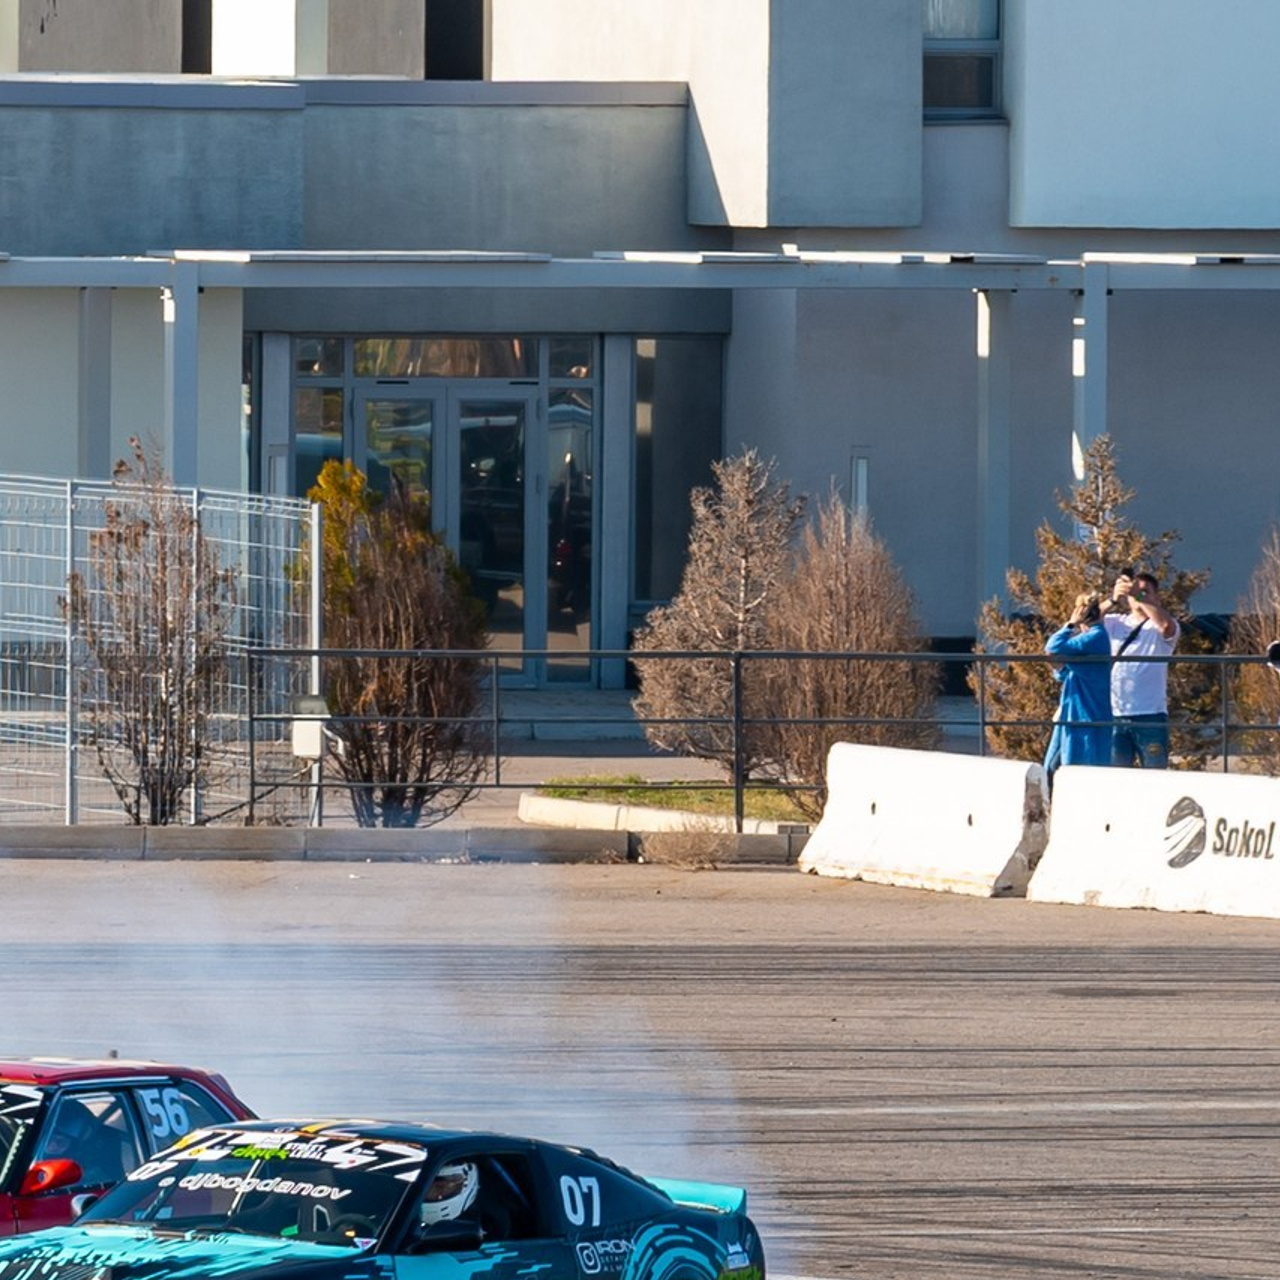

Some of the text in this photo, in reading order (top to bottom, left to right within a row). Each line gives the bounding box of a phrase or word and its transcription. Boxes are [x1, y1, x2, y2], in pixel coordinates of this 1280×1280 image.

[1211, 816, 1276, 860] Sokol
[140, 1087, 189, 1138] 56
[127, 1161, 178, 1181] 07
[178, 1172, 352, 1200] djbogdanov
[559, 1175, 601, 1227] 07
[594, 1239, 636, 1254] IRON
